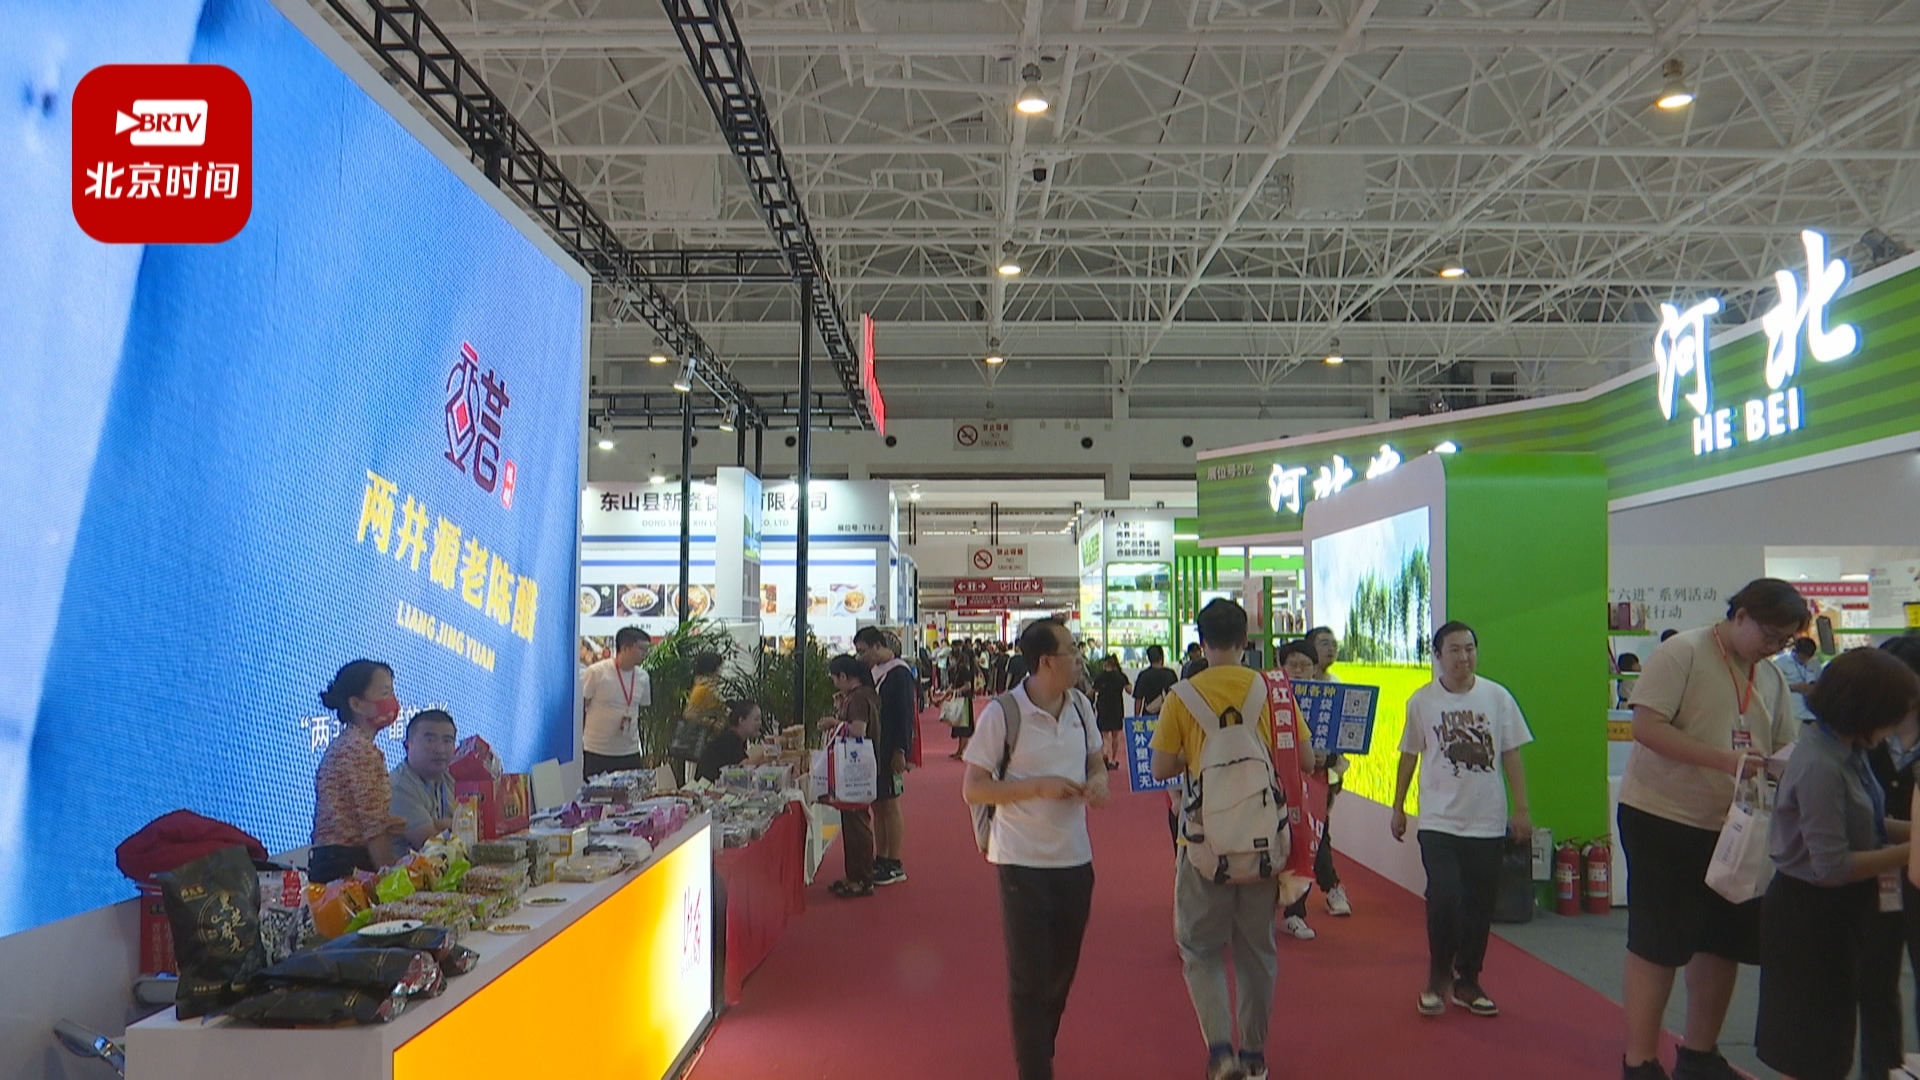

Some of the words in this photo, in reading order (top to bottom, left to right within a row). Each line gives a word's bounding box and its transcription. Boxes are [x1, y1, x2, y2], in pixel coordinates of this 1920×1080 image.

[1693, 408, 1737, 455] HE
[1745, 387, 1804, 441] BEI
[357, 469, 538, 642] 两井源老陈醋
[396, 599, 436, 641] LIANG
[436, 621, 464, 656] JING
[466, 635, 496, 672] YUAN
